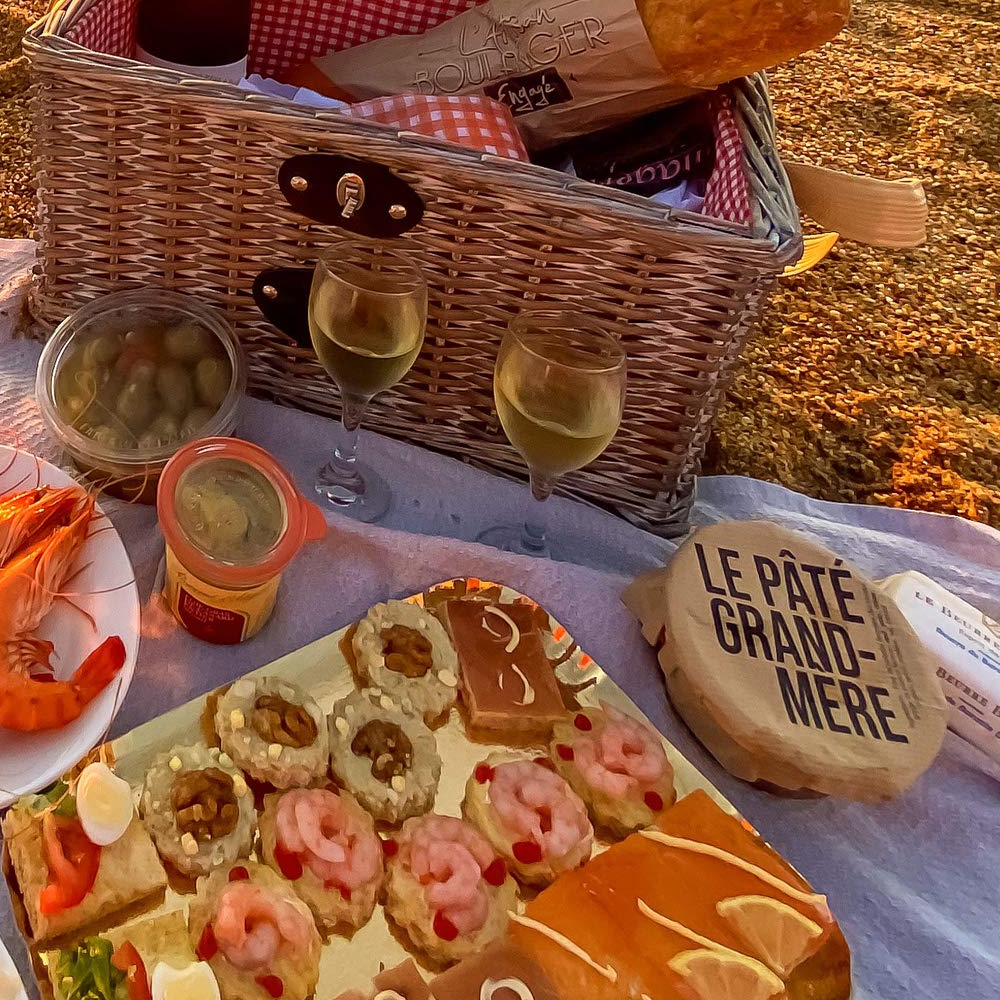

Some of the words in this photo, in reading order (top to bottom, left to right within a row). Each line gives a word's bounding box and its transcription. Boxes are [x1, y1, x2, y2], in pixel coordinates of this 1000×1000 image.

[694, 543, 752, 601] LE
[753, 549, 865, 624] PÂTÉ
[710, 597, 877, 678] GRAND-
